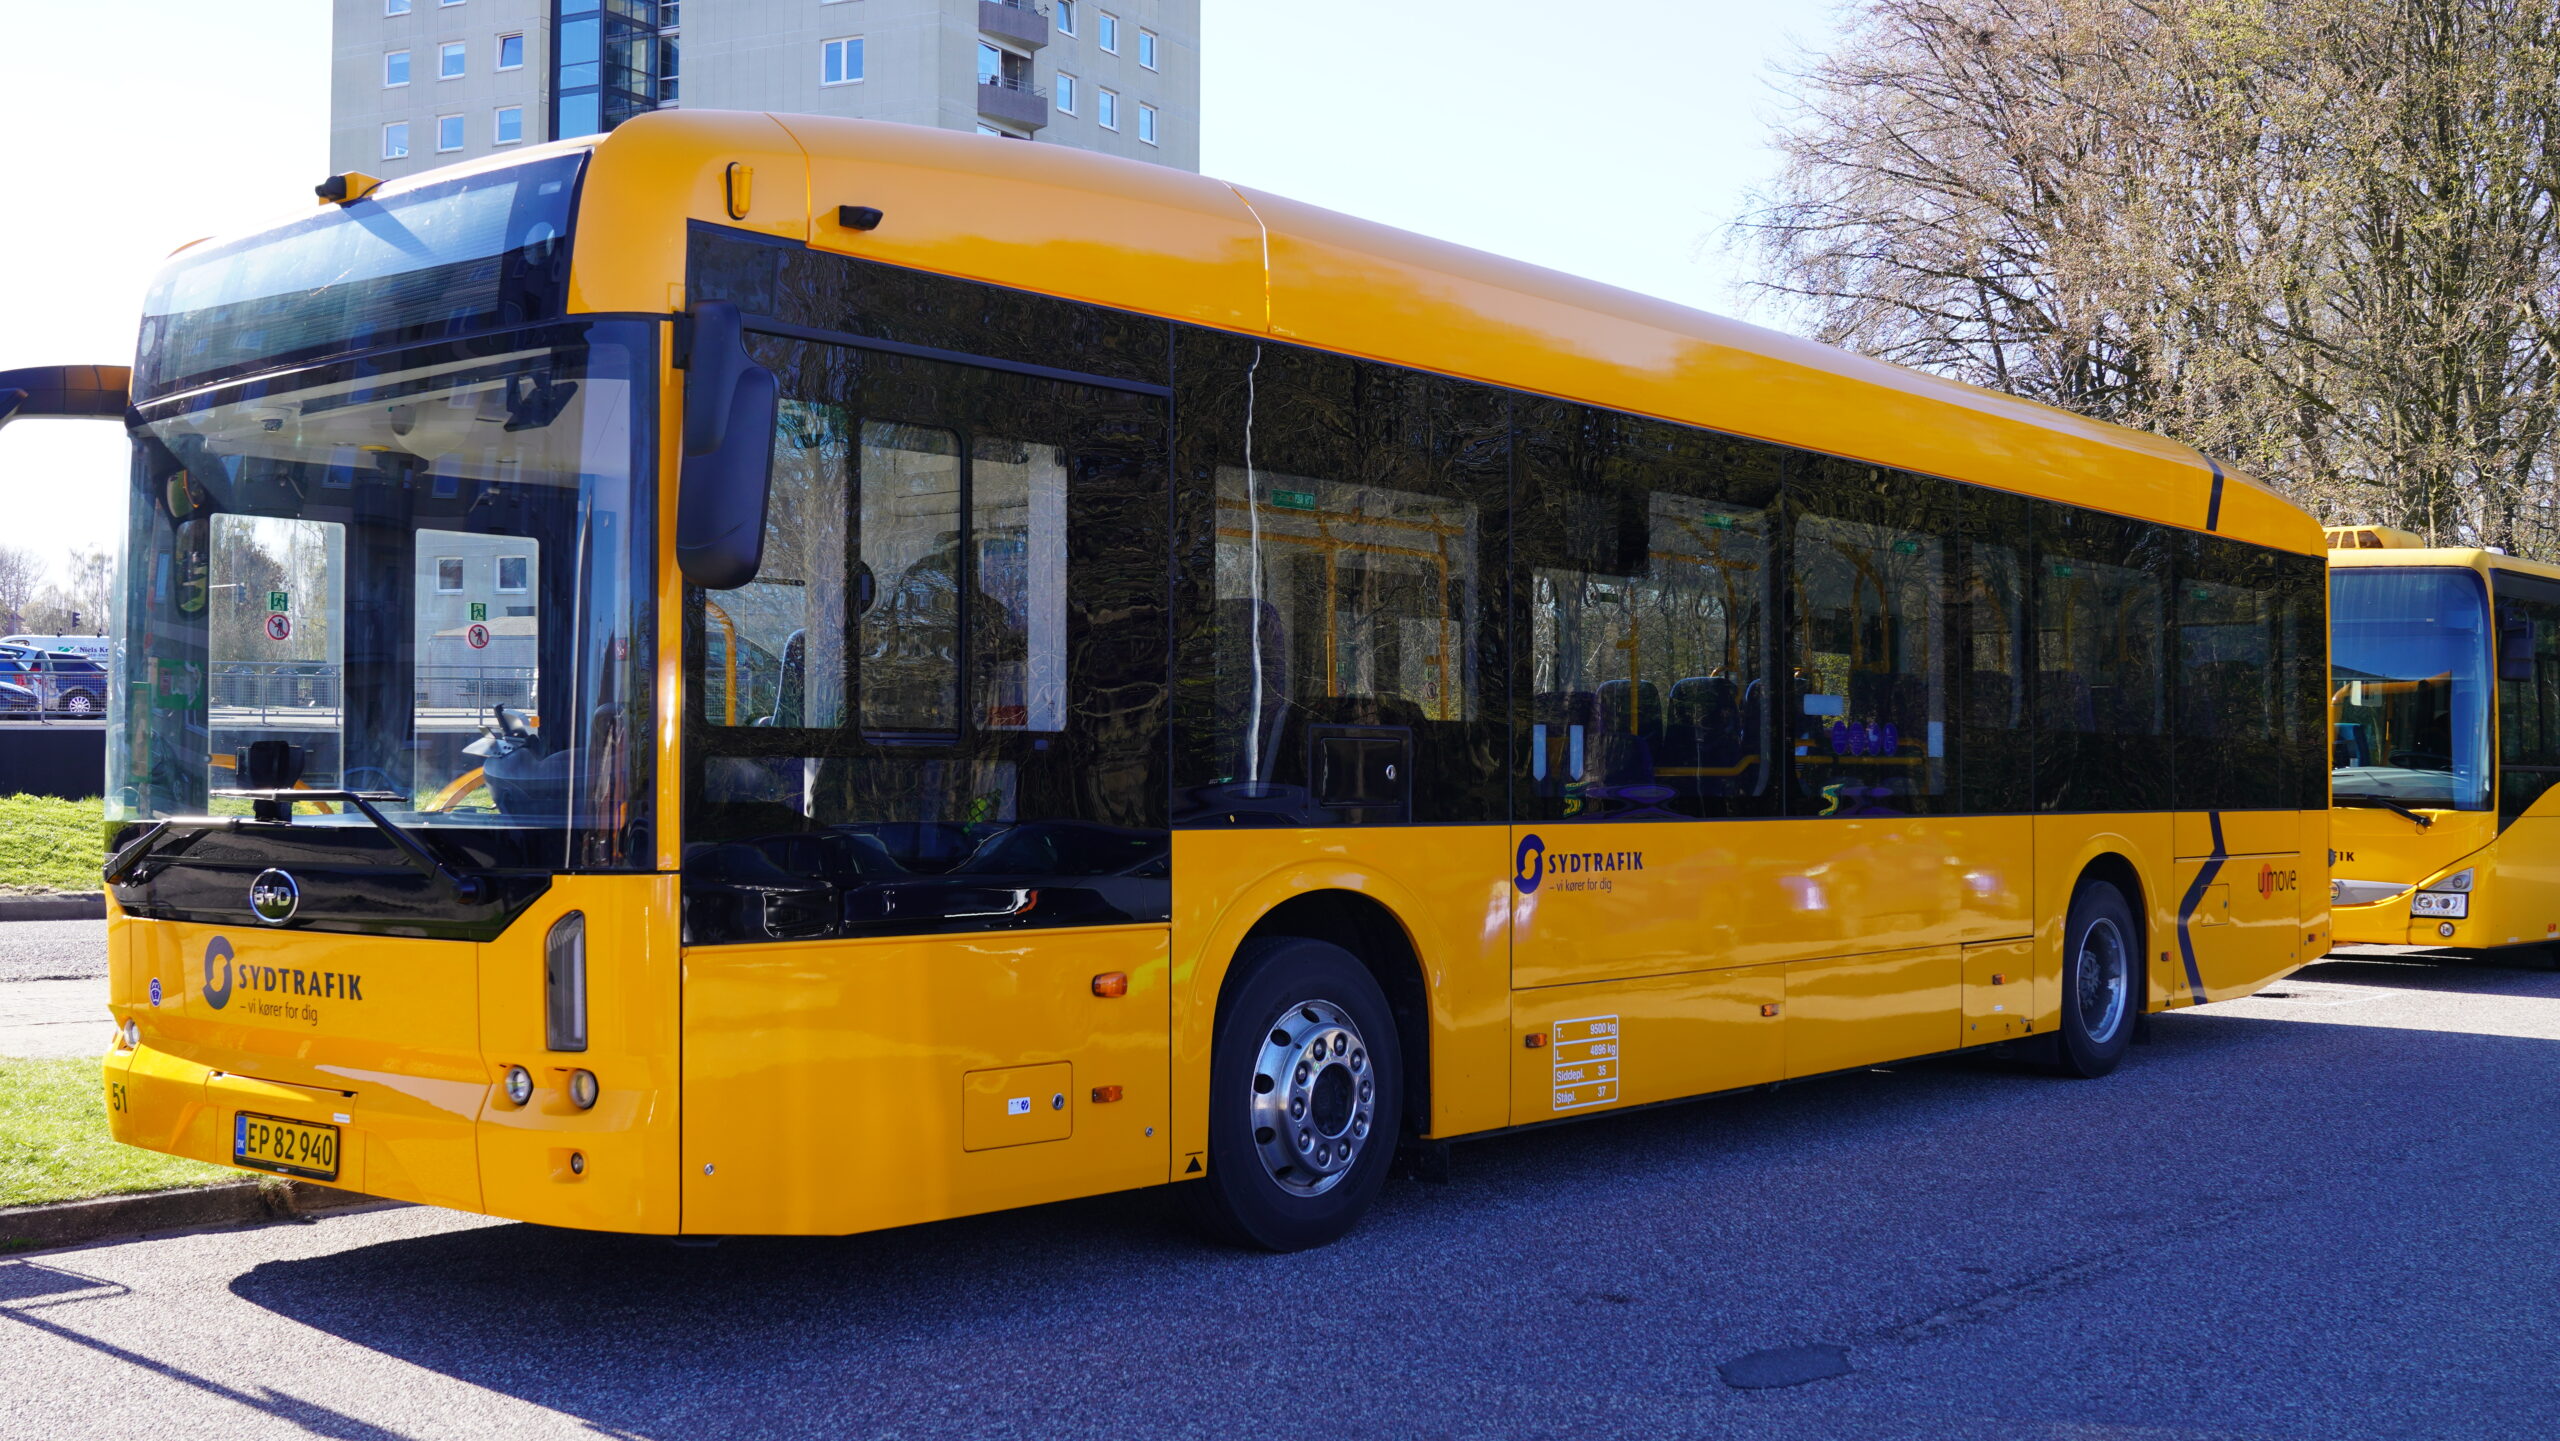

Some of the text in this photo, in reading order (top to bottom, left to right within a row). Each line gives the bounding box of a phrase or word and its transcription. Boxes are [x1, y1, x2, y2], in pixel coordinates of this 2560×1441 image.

[1548, 851, 1643, 874] SYDTRAFIK
[1556, 879, 1564, 892] vi
[1565, 879, 1585, 892] kører
[1587, 878, 1598, 891] for
[1600, 876, 1612, 893] dig
[254, 885, 291, 906] BYD
[239, 963, 363, 1001] SYDTRAFIK
[247, 998, 256, 1013] vi
[258, 1001, 282, 1017] kører
[285, 1001, 299, 1019] for
[301, 1003, 318, 1027] dig
[1590, 1022, 1606, 1035] 9500
[1607, 1022, 1616, 1035] kg
[1607, 1043, 1616, 1056] kg
[1556, 1068, 1585, 1082] Siddepl.
[112, 1082, 127, 1113] 51
[1556, 1086, 1607, 1105] Ståpl. 37
[247, 1123, 269, 1154] EP
[274, 1126, 295, 1160] 82
[300, 1131, 332, 1166] 940
